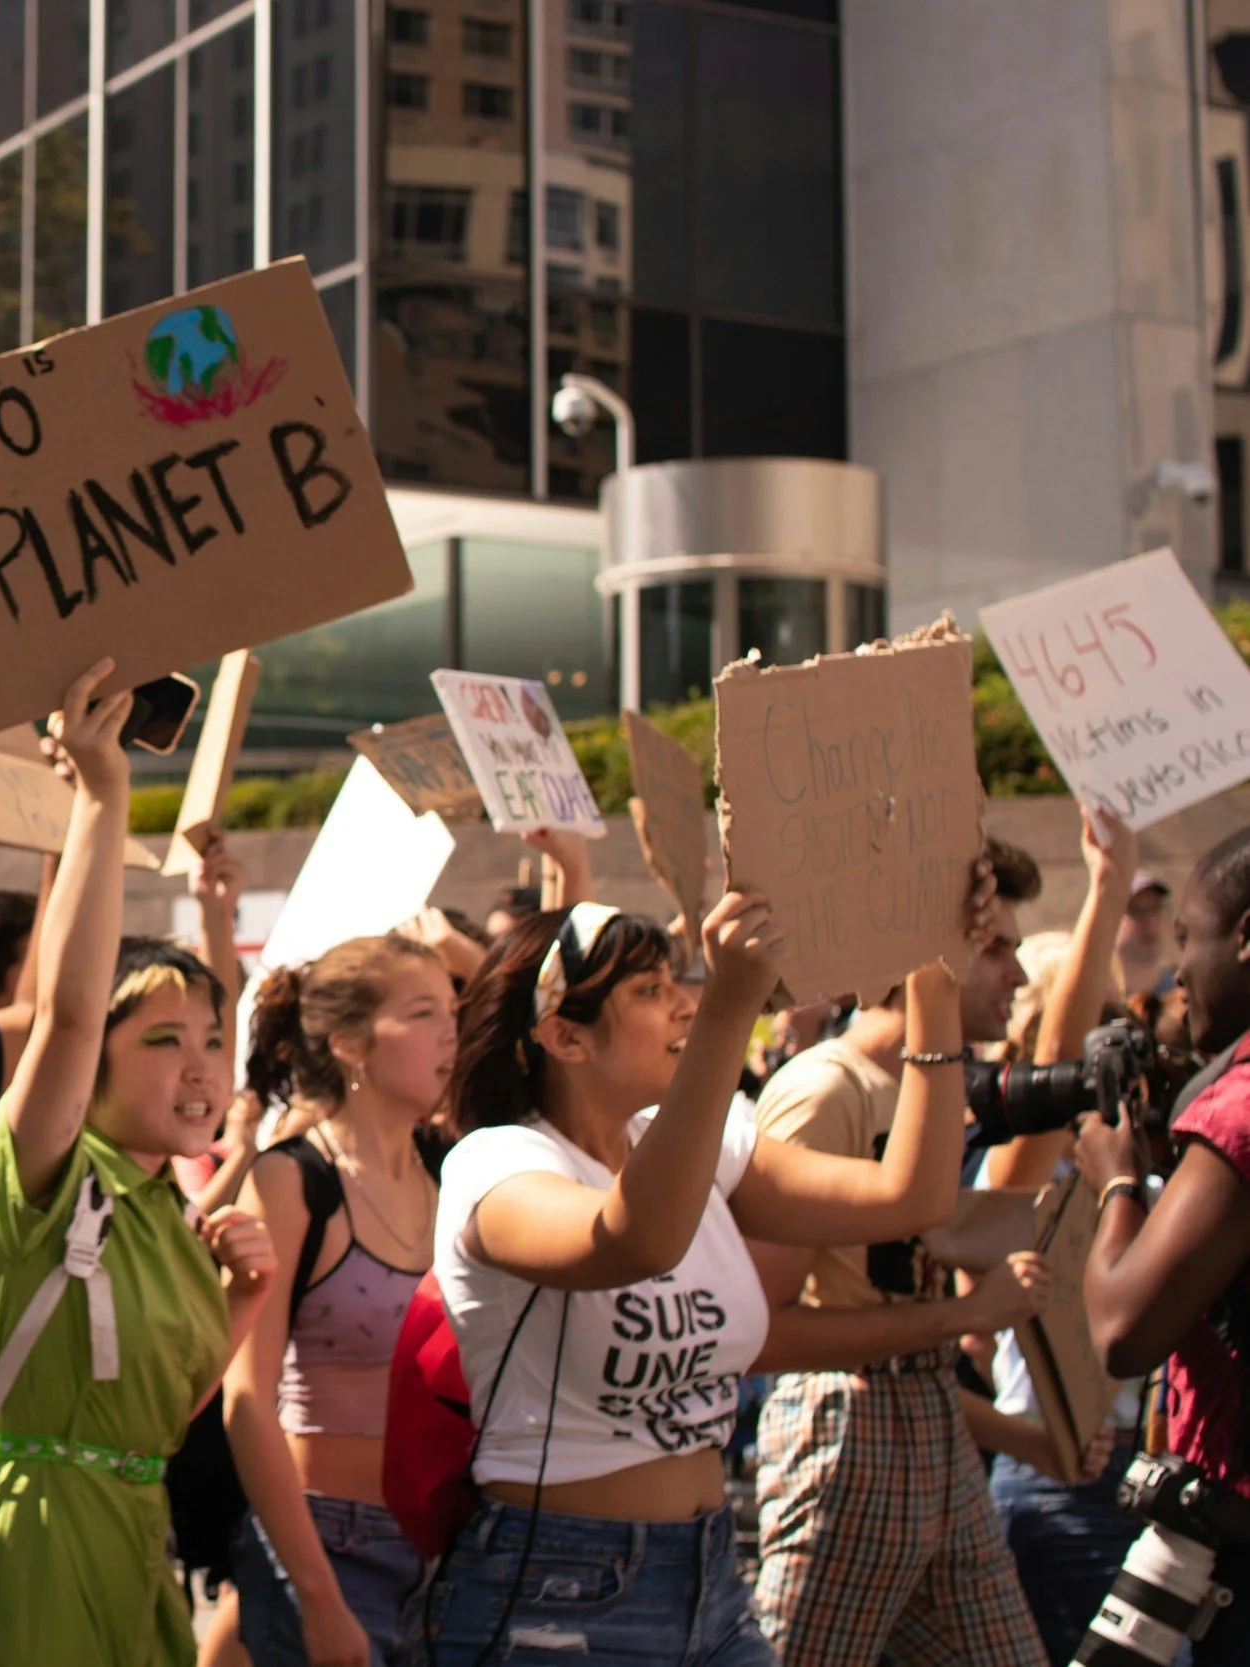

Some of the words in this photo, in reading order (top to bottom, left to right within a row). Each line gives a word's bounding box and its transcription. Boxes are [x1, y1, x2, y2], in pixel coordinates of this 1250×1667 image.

[22, 349, 56, 378] IS
[1002, 602, 1158, 713] 4645
[612, 1288, 726, 1343] SUIS
[602, 1339, 718, 1390] UNE
